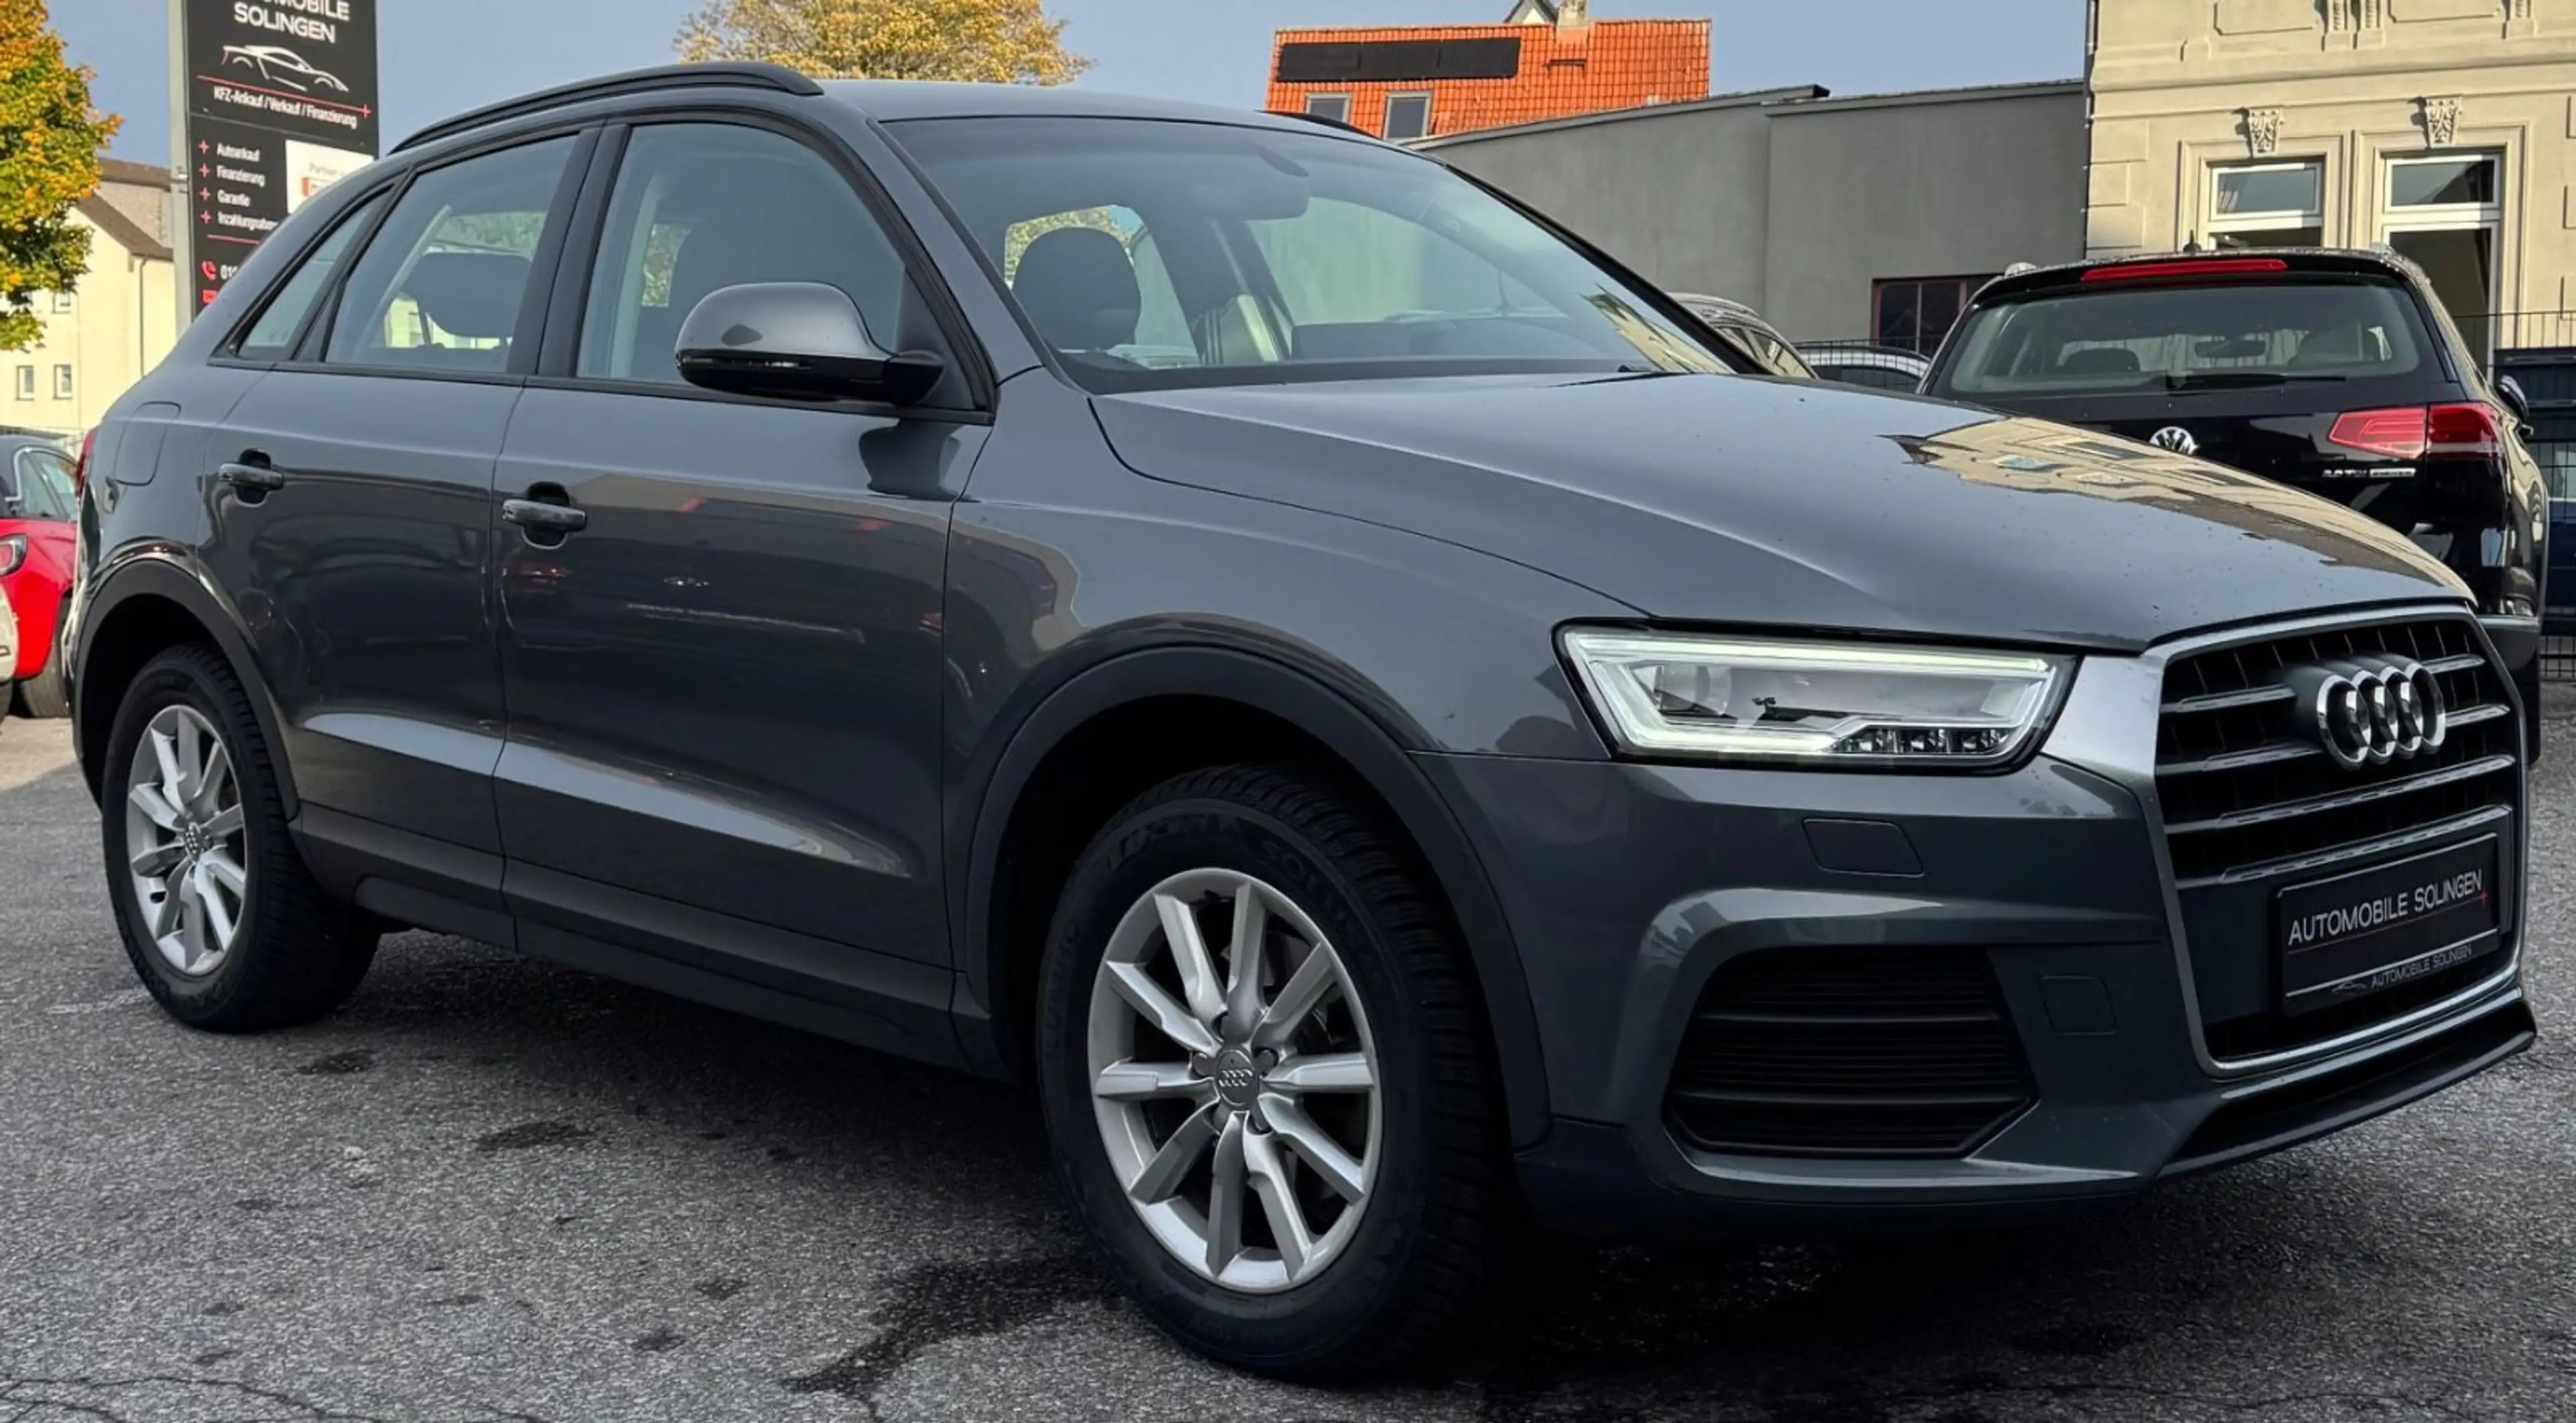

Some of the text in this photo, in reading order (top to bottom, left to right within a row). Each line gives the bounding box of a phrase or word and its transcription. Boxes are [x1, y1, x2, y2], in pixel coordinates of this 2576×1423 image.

[234, 2, 335, 43] SOLINGEN
[214, 86, 263, 108] KFZ-Ankauf
[269, 97, 301, 115] Verkauf
[307, 104, 358, 129] Finanzierung
[217, 143, 260, 162] Autoankauf
[217, 165, 266, 188] Finanzierung
[217, 189, 250, 207] Garantie
[2288, 869, 2483, 946] AUTOMOBILE SOLINGEN
[2371, 943, 2472, 988] AUTOMOBILE SOLINGEN
